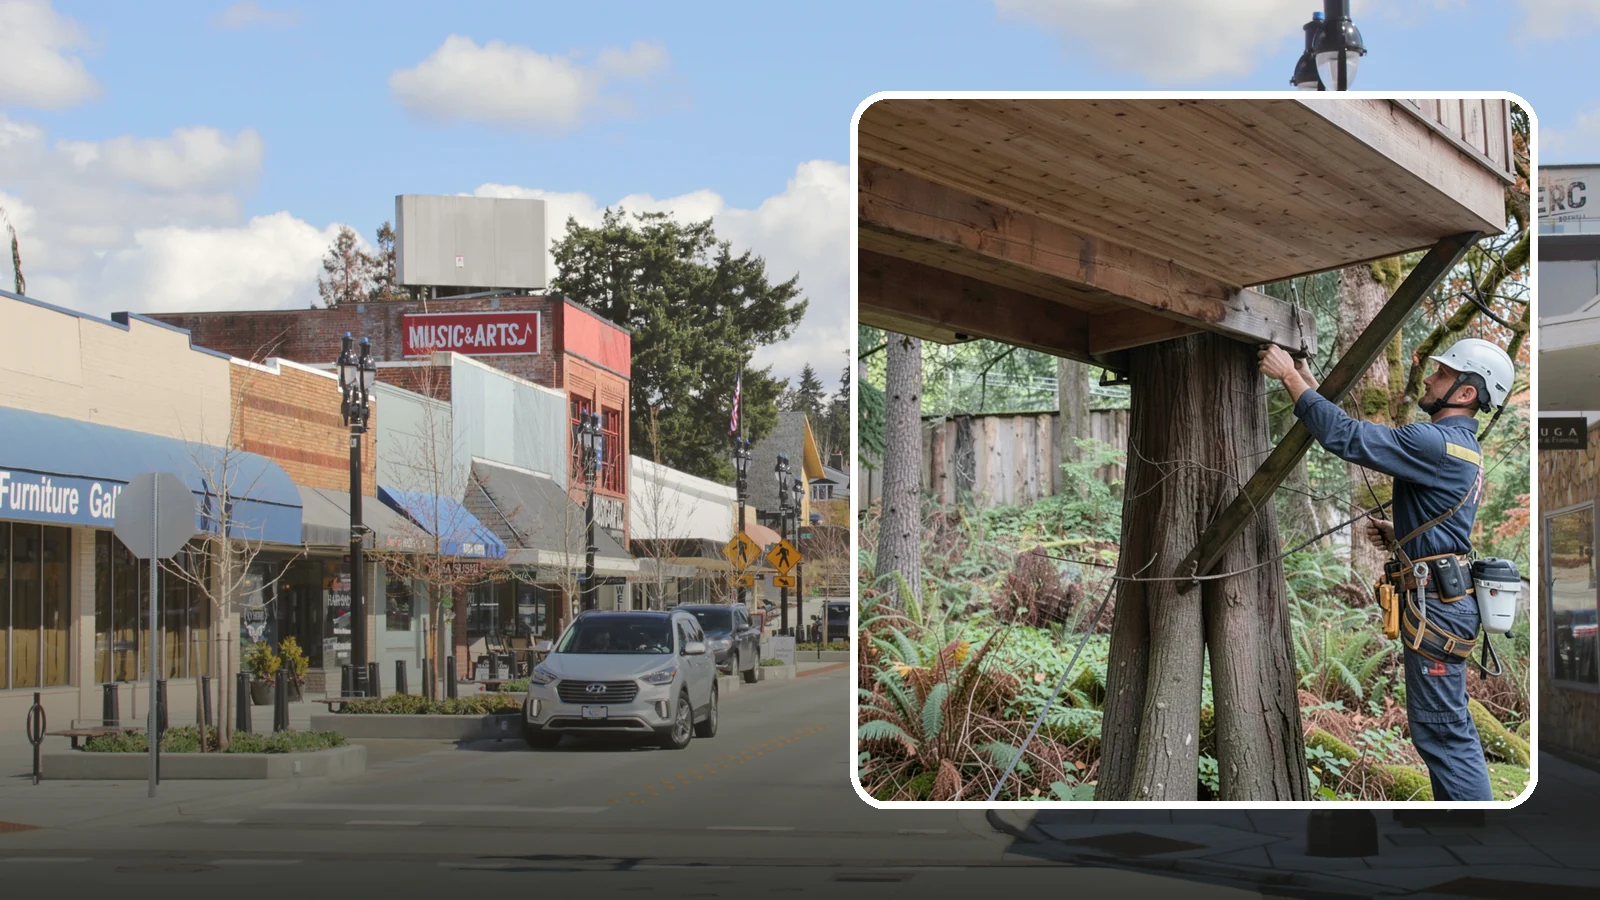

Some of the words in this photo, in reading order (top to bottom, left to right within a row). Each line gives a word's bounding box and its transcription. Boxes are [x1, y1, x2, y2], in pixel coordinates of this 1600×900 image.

[1540, 427, 1577, 437] UGA
[0, 472, 79, 515] Furniture
[89, 482, 122, 519] Gal
